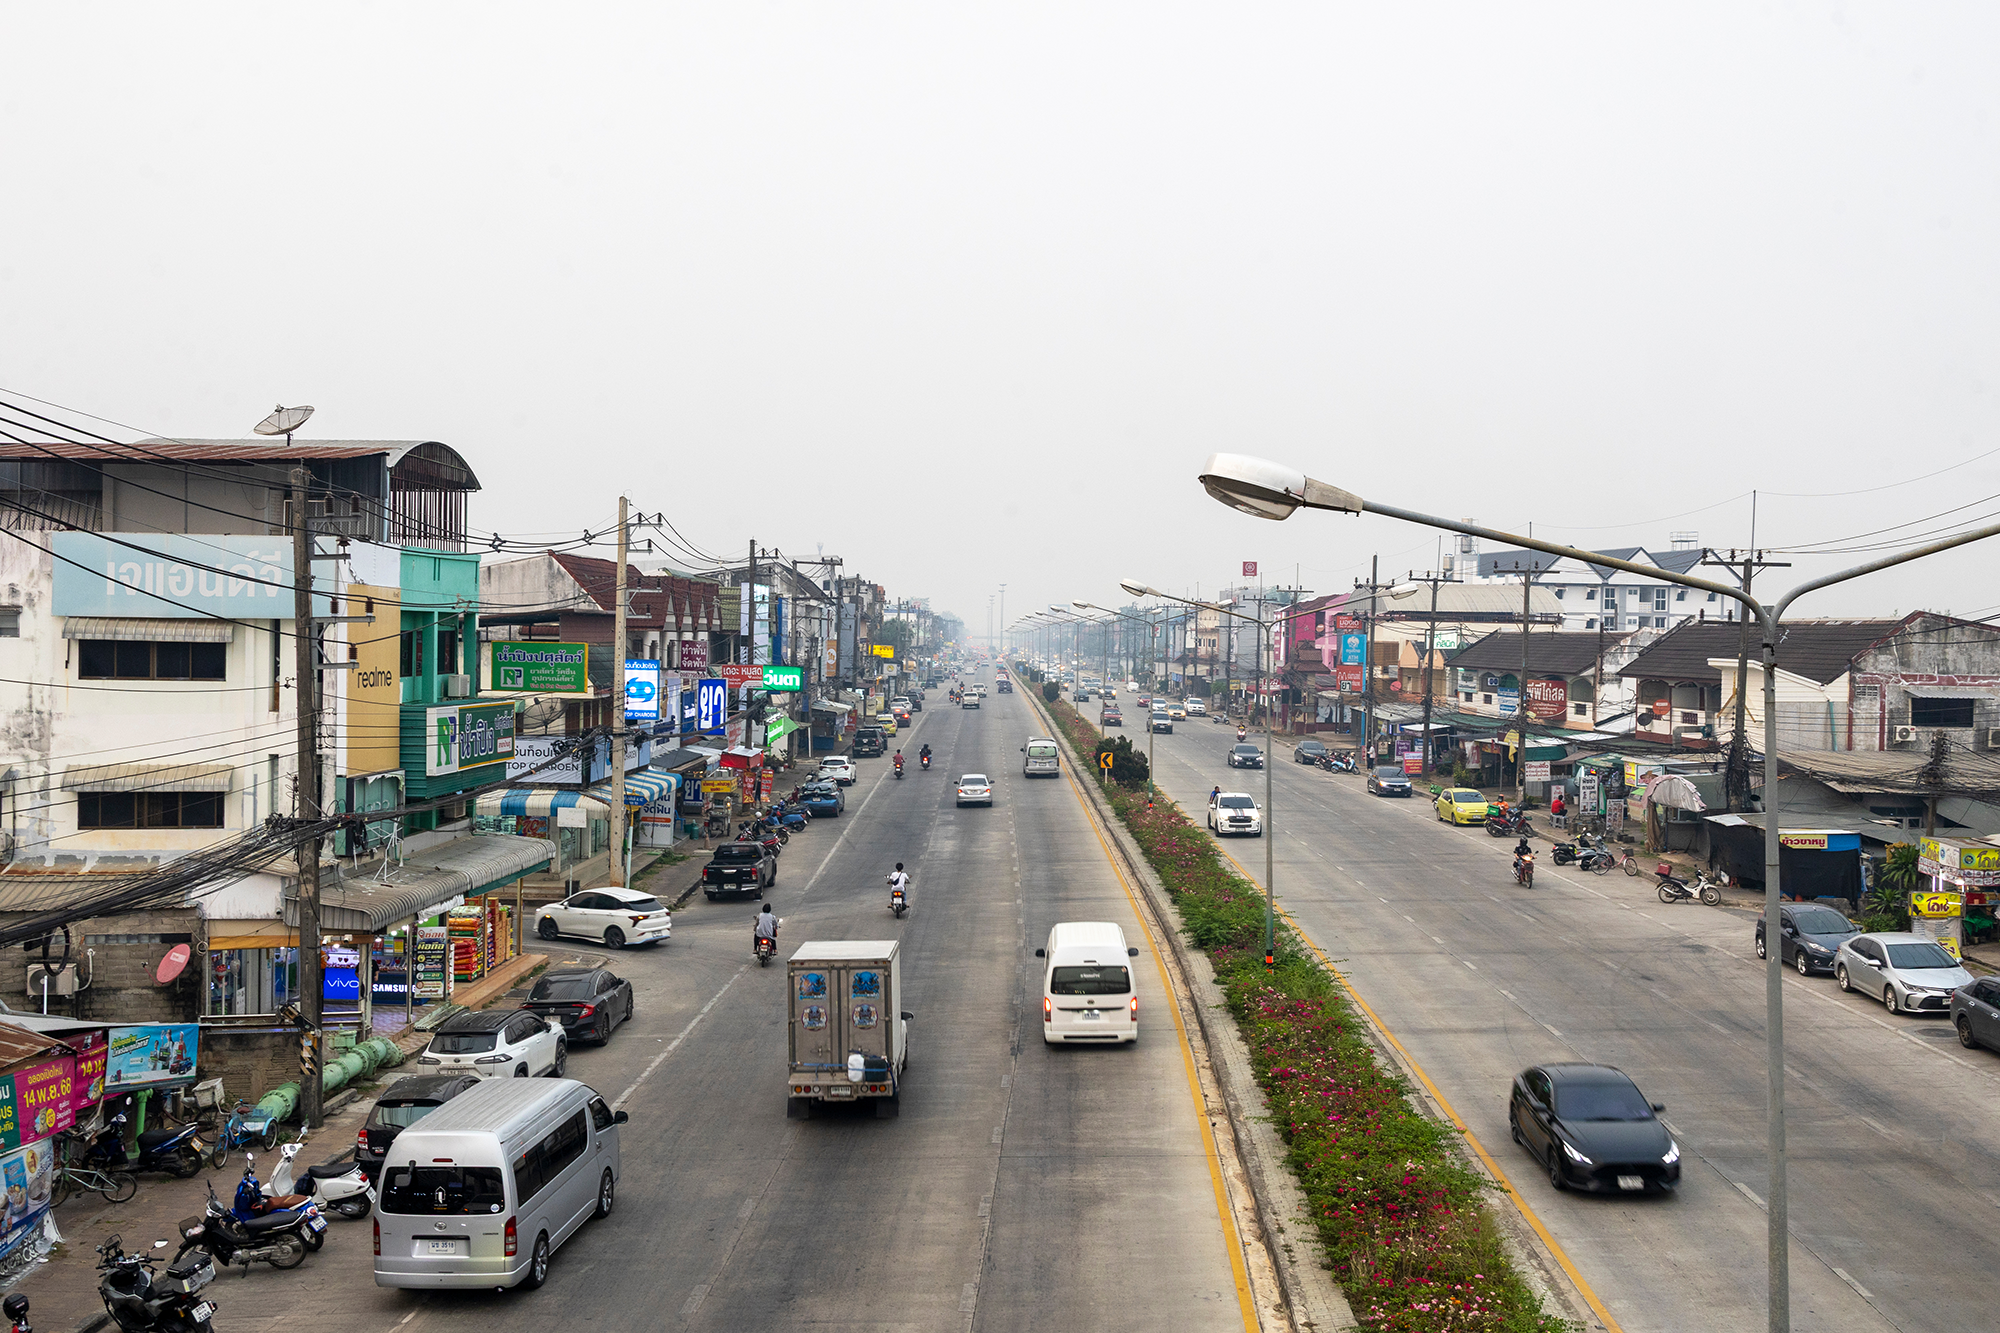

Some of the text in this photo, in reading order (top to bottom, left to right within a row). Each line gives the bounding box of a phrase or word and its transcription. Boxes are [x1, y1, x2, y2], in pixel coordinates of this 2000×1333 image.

[497, 645, 585, 667] น้ำปิงปศุสัตว์
[682, 643, 706, 655] ทำฟัน
[682, 656, 706, 668] จัดฟัน
[358, 666, 392, 688] realme
[763, 669, 800, 687] ว่นตา
[700, 685, 725, 730] ยา
[460, 713, 494, 759] น้ำปิง
[507, 761, 526, 769] TOP
[684, 779, 703, 801] ยา
[643, 803, 671, 815] จัดฟัน
[1782, 836, 1826, 848] ข้าวขาหมู
[327, 977, 359, 988] vivo
[28, 1063, 63, 1085] ฉลองเปิดใหม่
[23, 1077, 72, 1108] 14 พ.ย. 68
